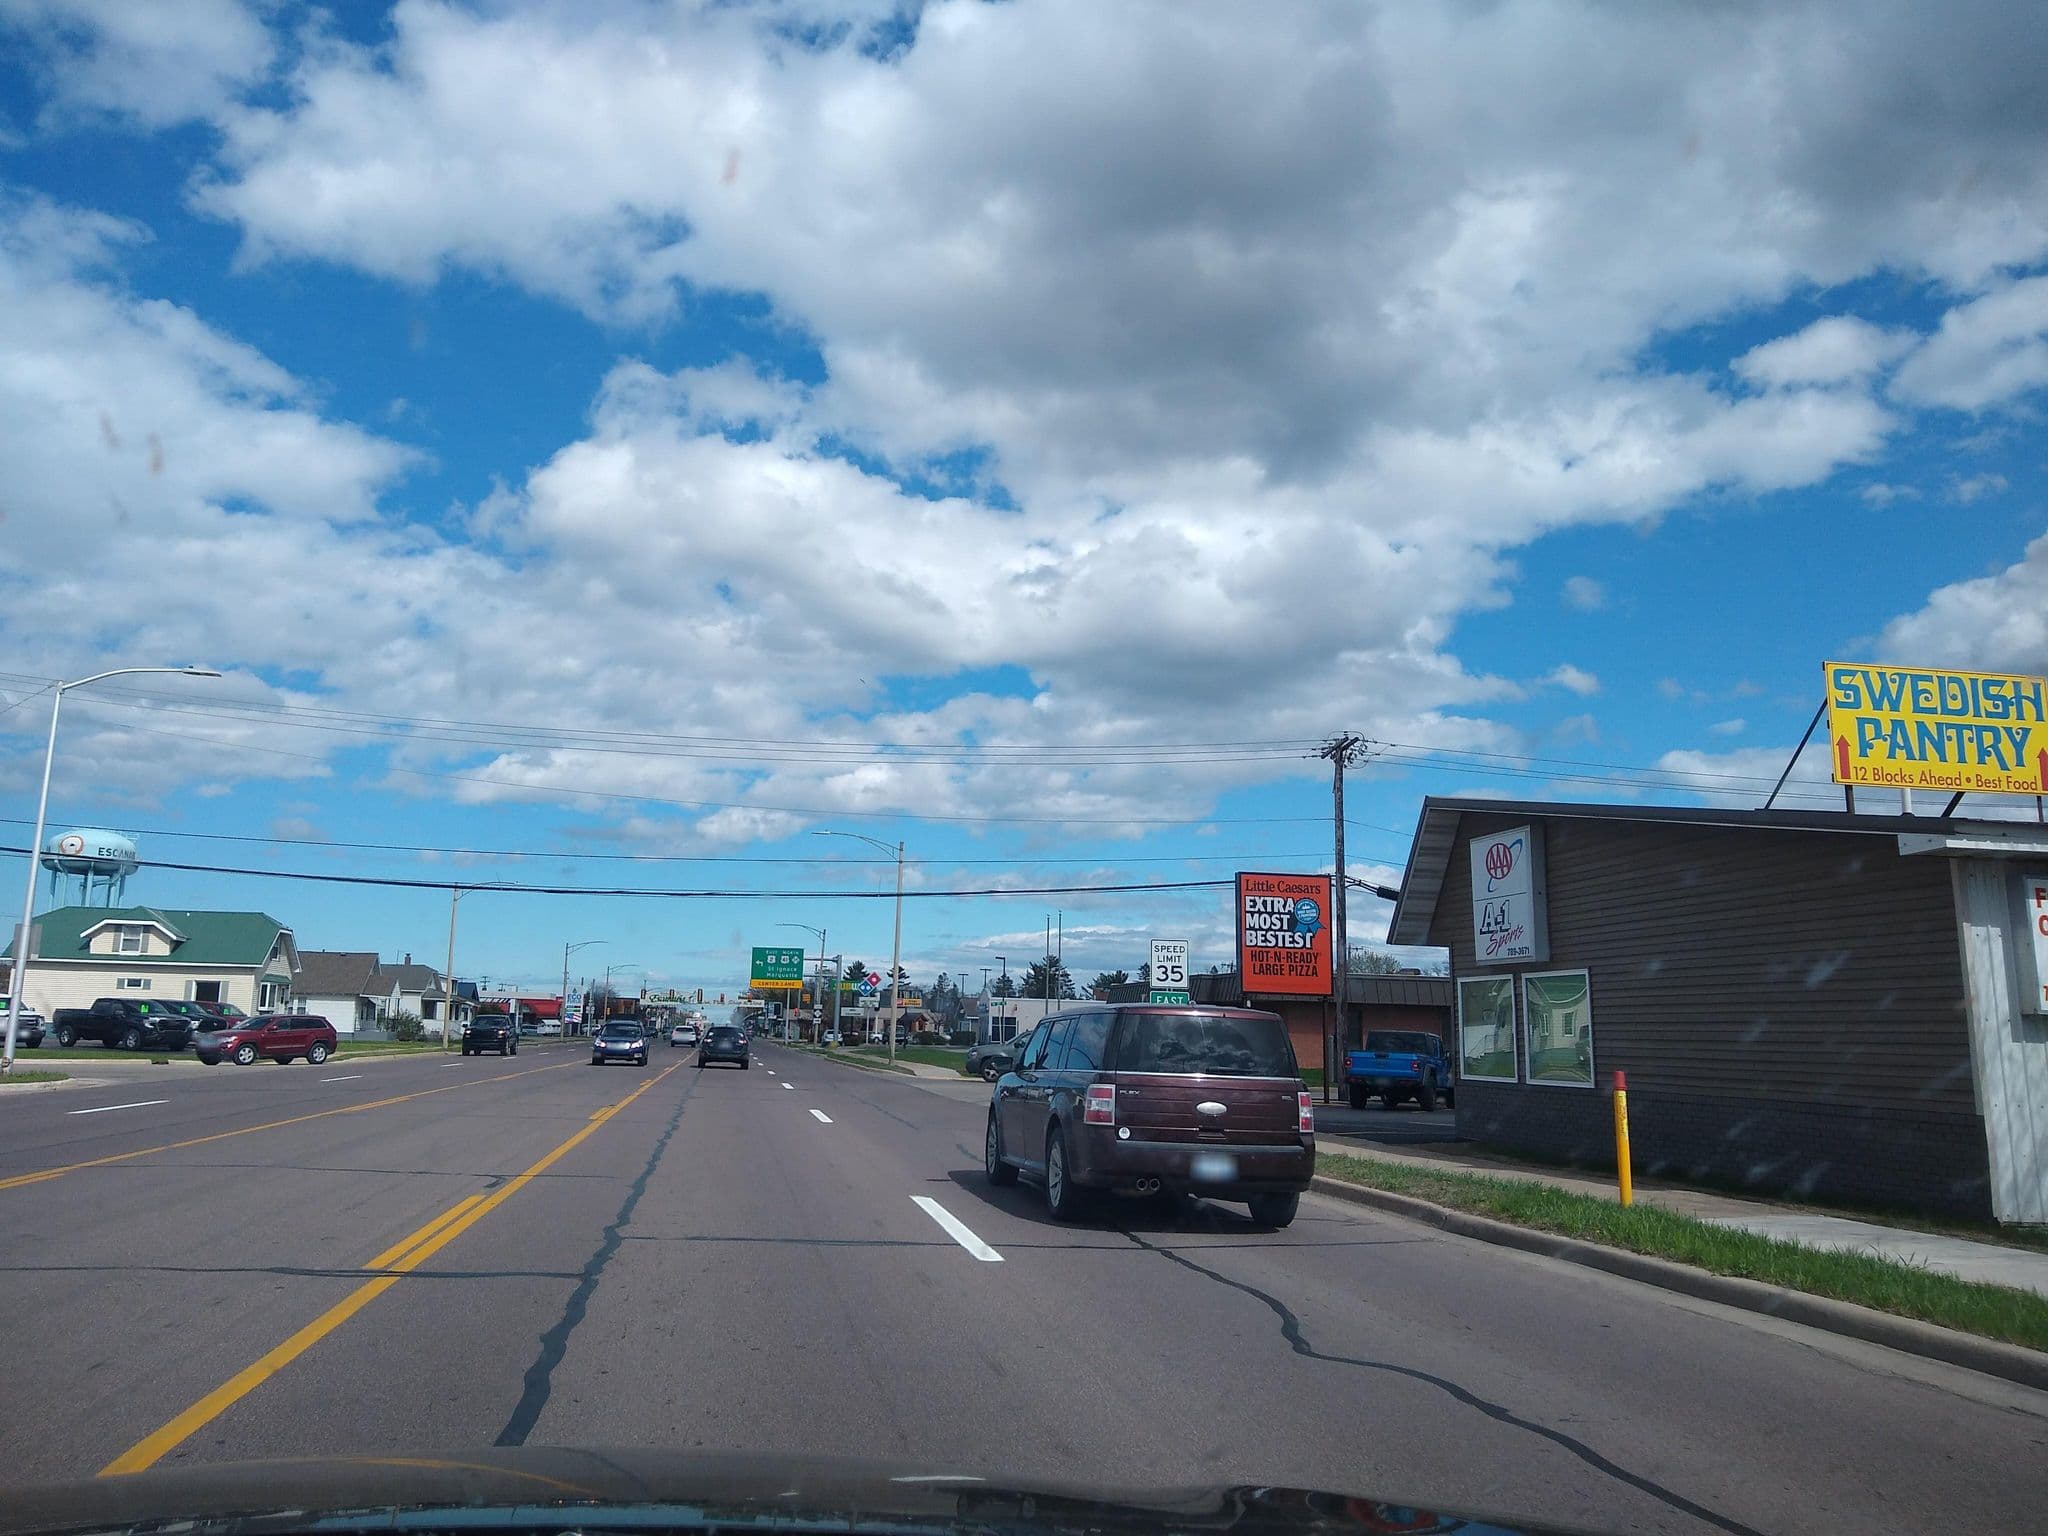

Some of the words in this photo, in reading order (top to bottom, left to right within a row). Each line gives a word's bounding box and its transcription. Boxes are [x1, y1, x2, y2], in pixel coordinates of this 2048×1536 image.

[1833, 668, 2046, 722] SWEDISH
[1856, 717, 2032, 771] PANTRY
[1853, 766, 1868, 781] 12
[1873, 767, 1914, 784] Blocks
[1919, 770, 1962, 787] Ahead
[1976, 774, 2002, 789] Best
[2006, 775, 2038, 791] Food
[1487, 844, 1511, 877] AAA
[1245, 879, 1275, 892] Little
[1277, 881, 1320, 894] Caesars
[1245, 896, 1294, 913] EXTRA
[1246, 913, 1290, 930] MOST
[1246, 930, 1313, 948] BESTEST
[1154, 945, 1185, 953] SPEED
[1251, 951, 1318, 964] HOT-N-READY
[1156, 965, 1183, 982] 35
[1253, 964, 1285, 976] LARGE
[1288, 965, 1318, 977] PIZZA
[1156, 995, 1184, 1005] EAST
